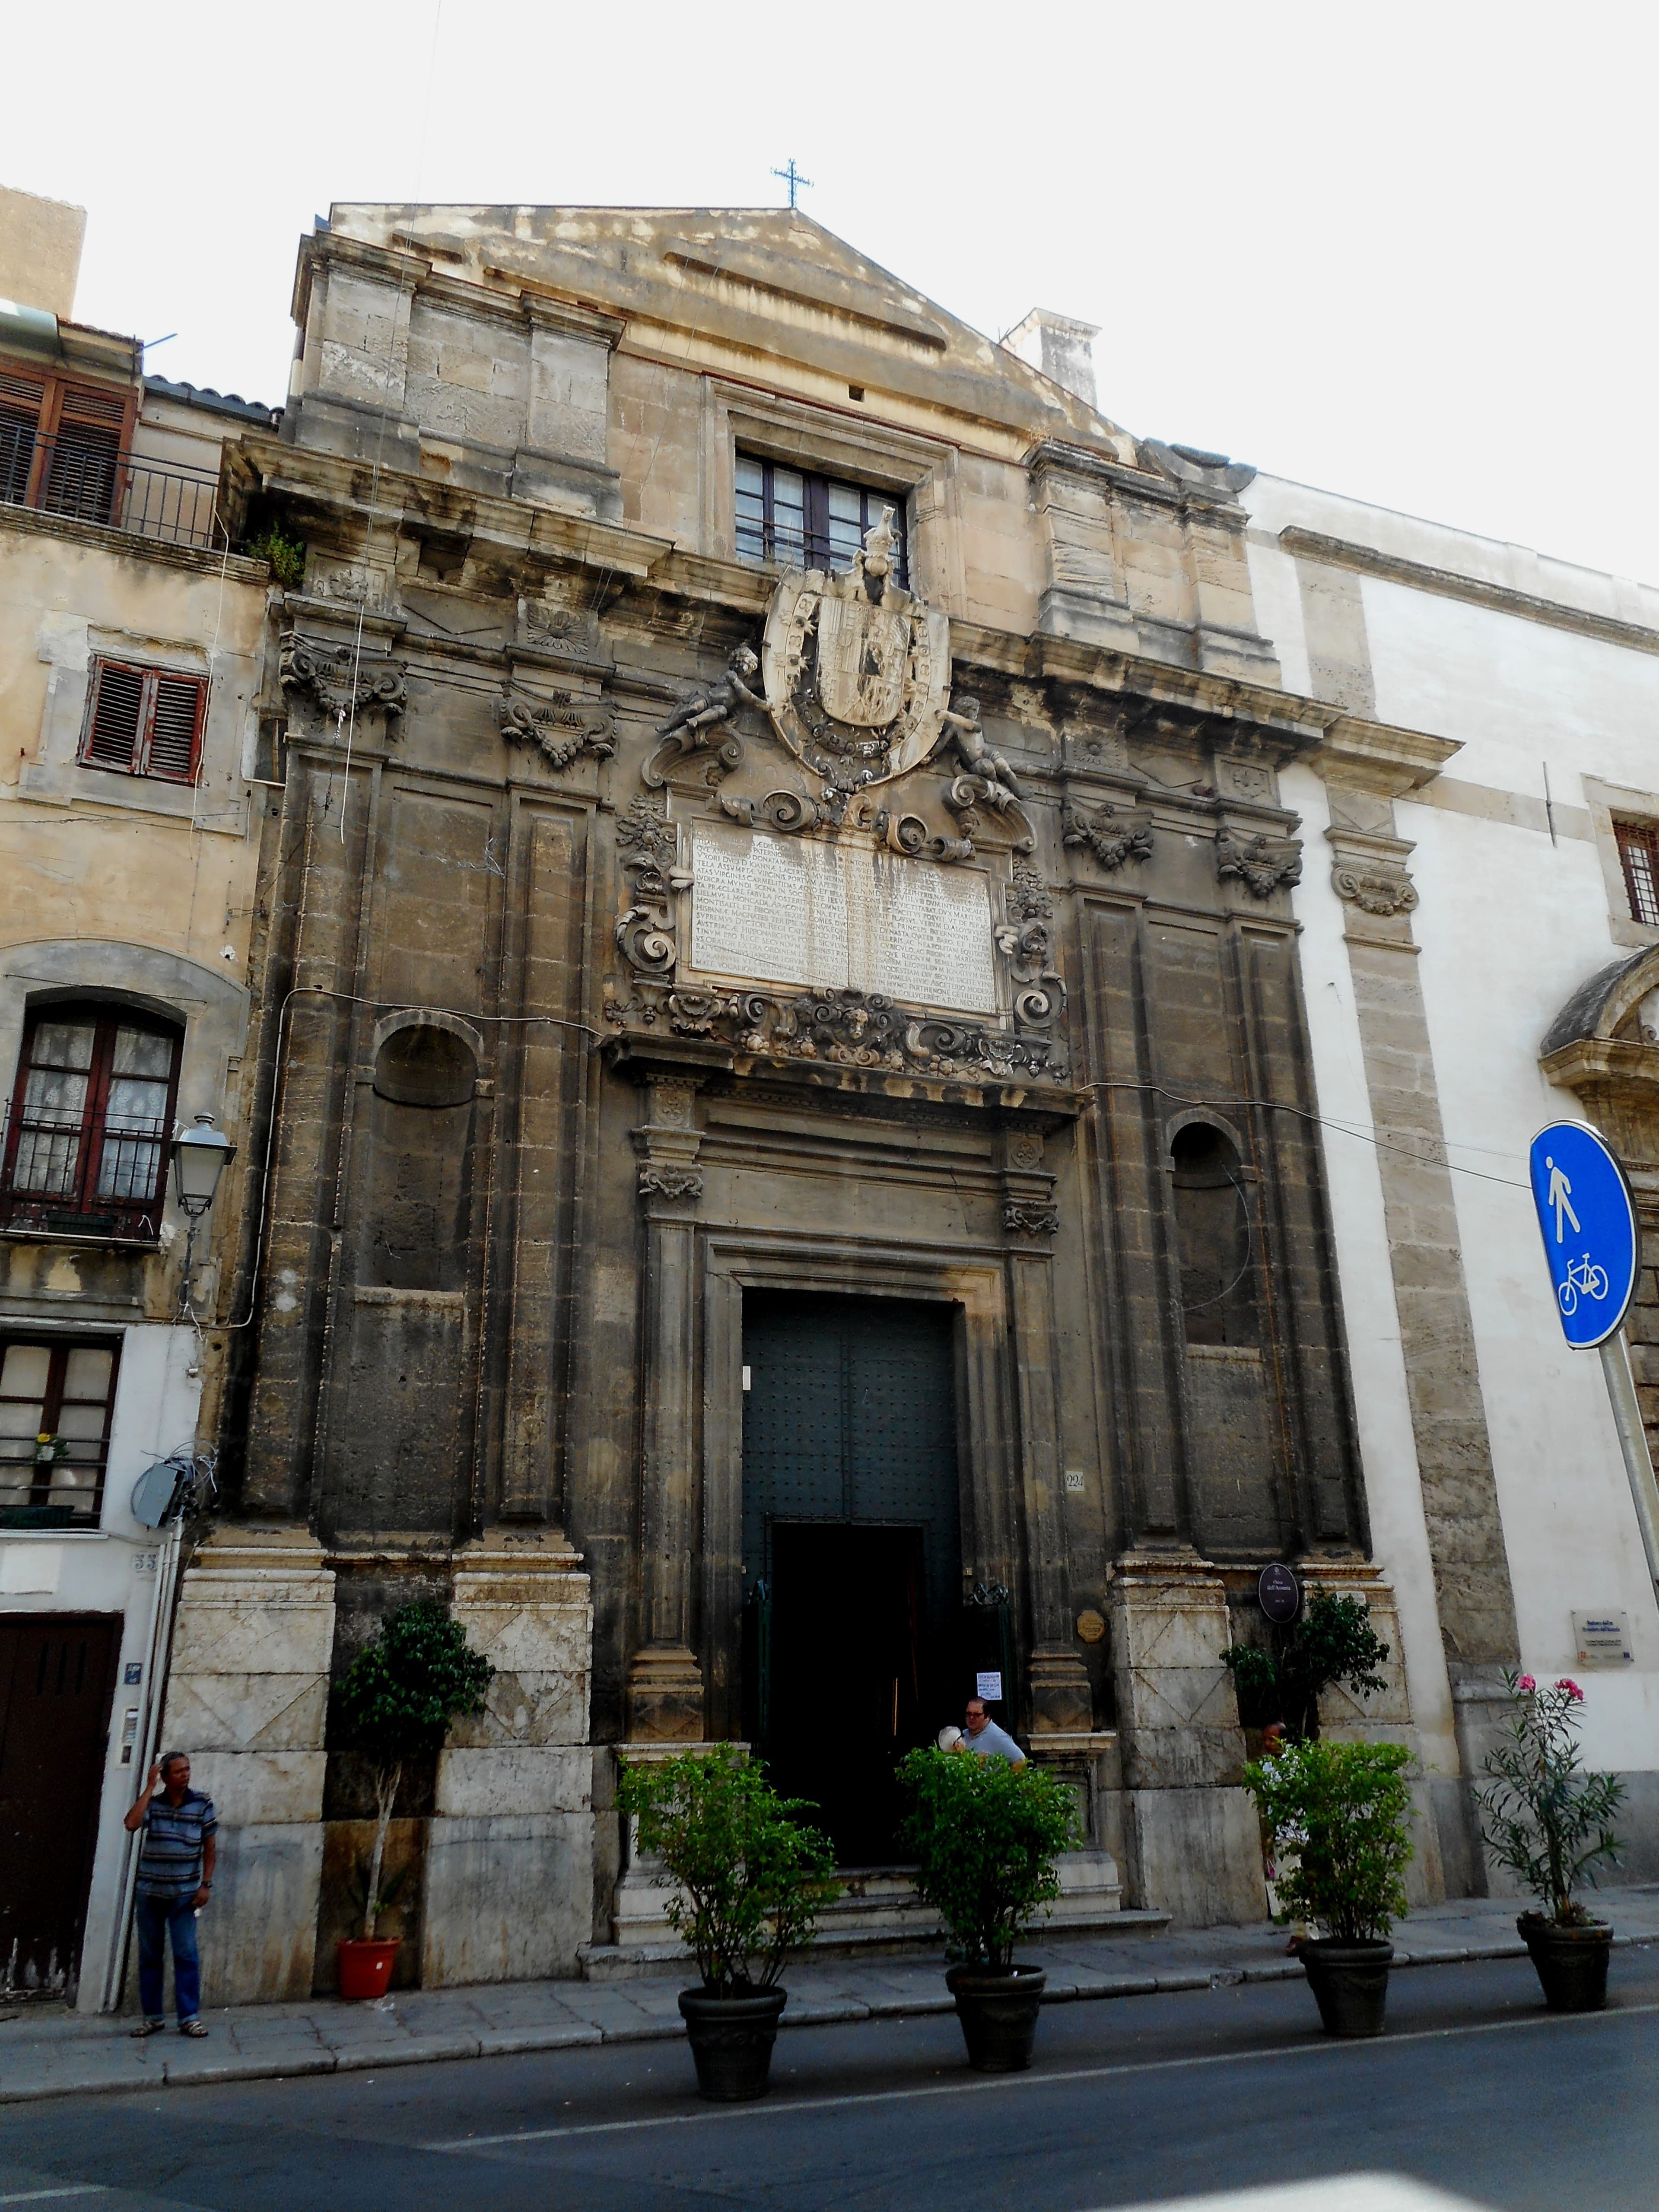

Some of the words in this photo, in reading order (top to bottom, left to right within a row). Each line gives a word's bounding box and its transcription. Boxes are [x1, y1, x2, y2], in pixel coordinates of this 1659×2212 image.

[696, 851, 720, 861] VXORI
[753, 853, 785, 865] DONATAM
[696, 866, 712, 875] ATAS
[714, 869, 745, 880] VIRGINES
[696, 873, 725, 884] LVDICRA
[727, 878, 751, 889] MVNDI
[754, 883, 776, 893] SCENA
[696, 858, 714, 868] TELA
[941, 902, 960, 911] INTER
[747, 889, 772, 899] FABVLA
[820, 902, 844, 912] OMNES
[696, 911, 733, 923] SVPREMVS
[696, 926, 720, 936] TINVM
[1067, 1475, 1083, 1487] 224
